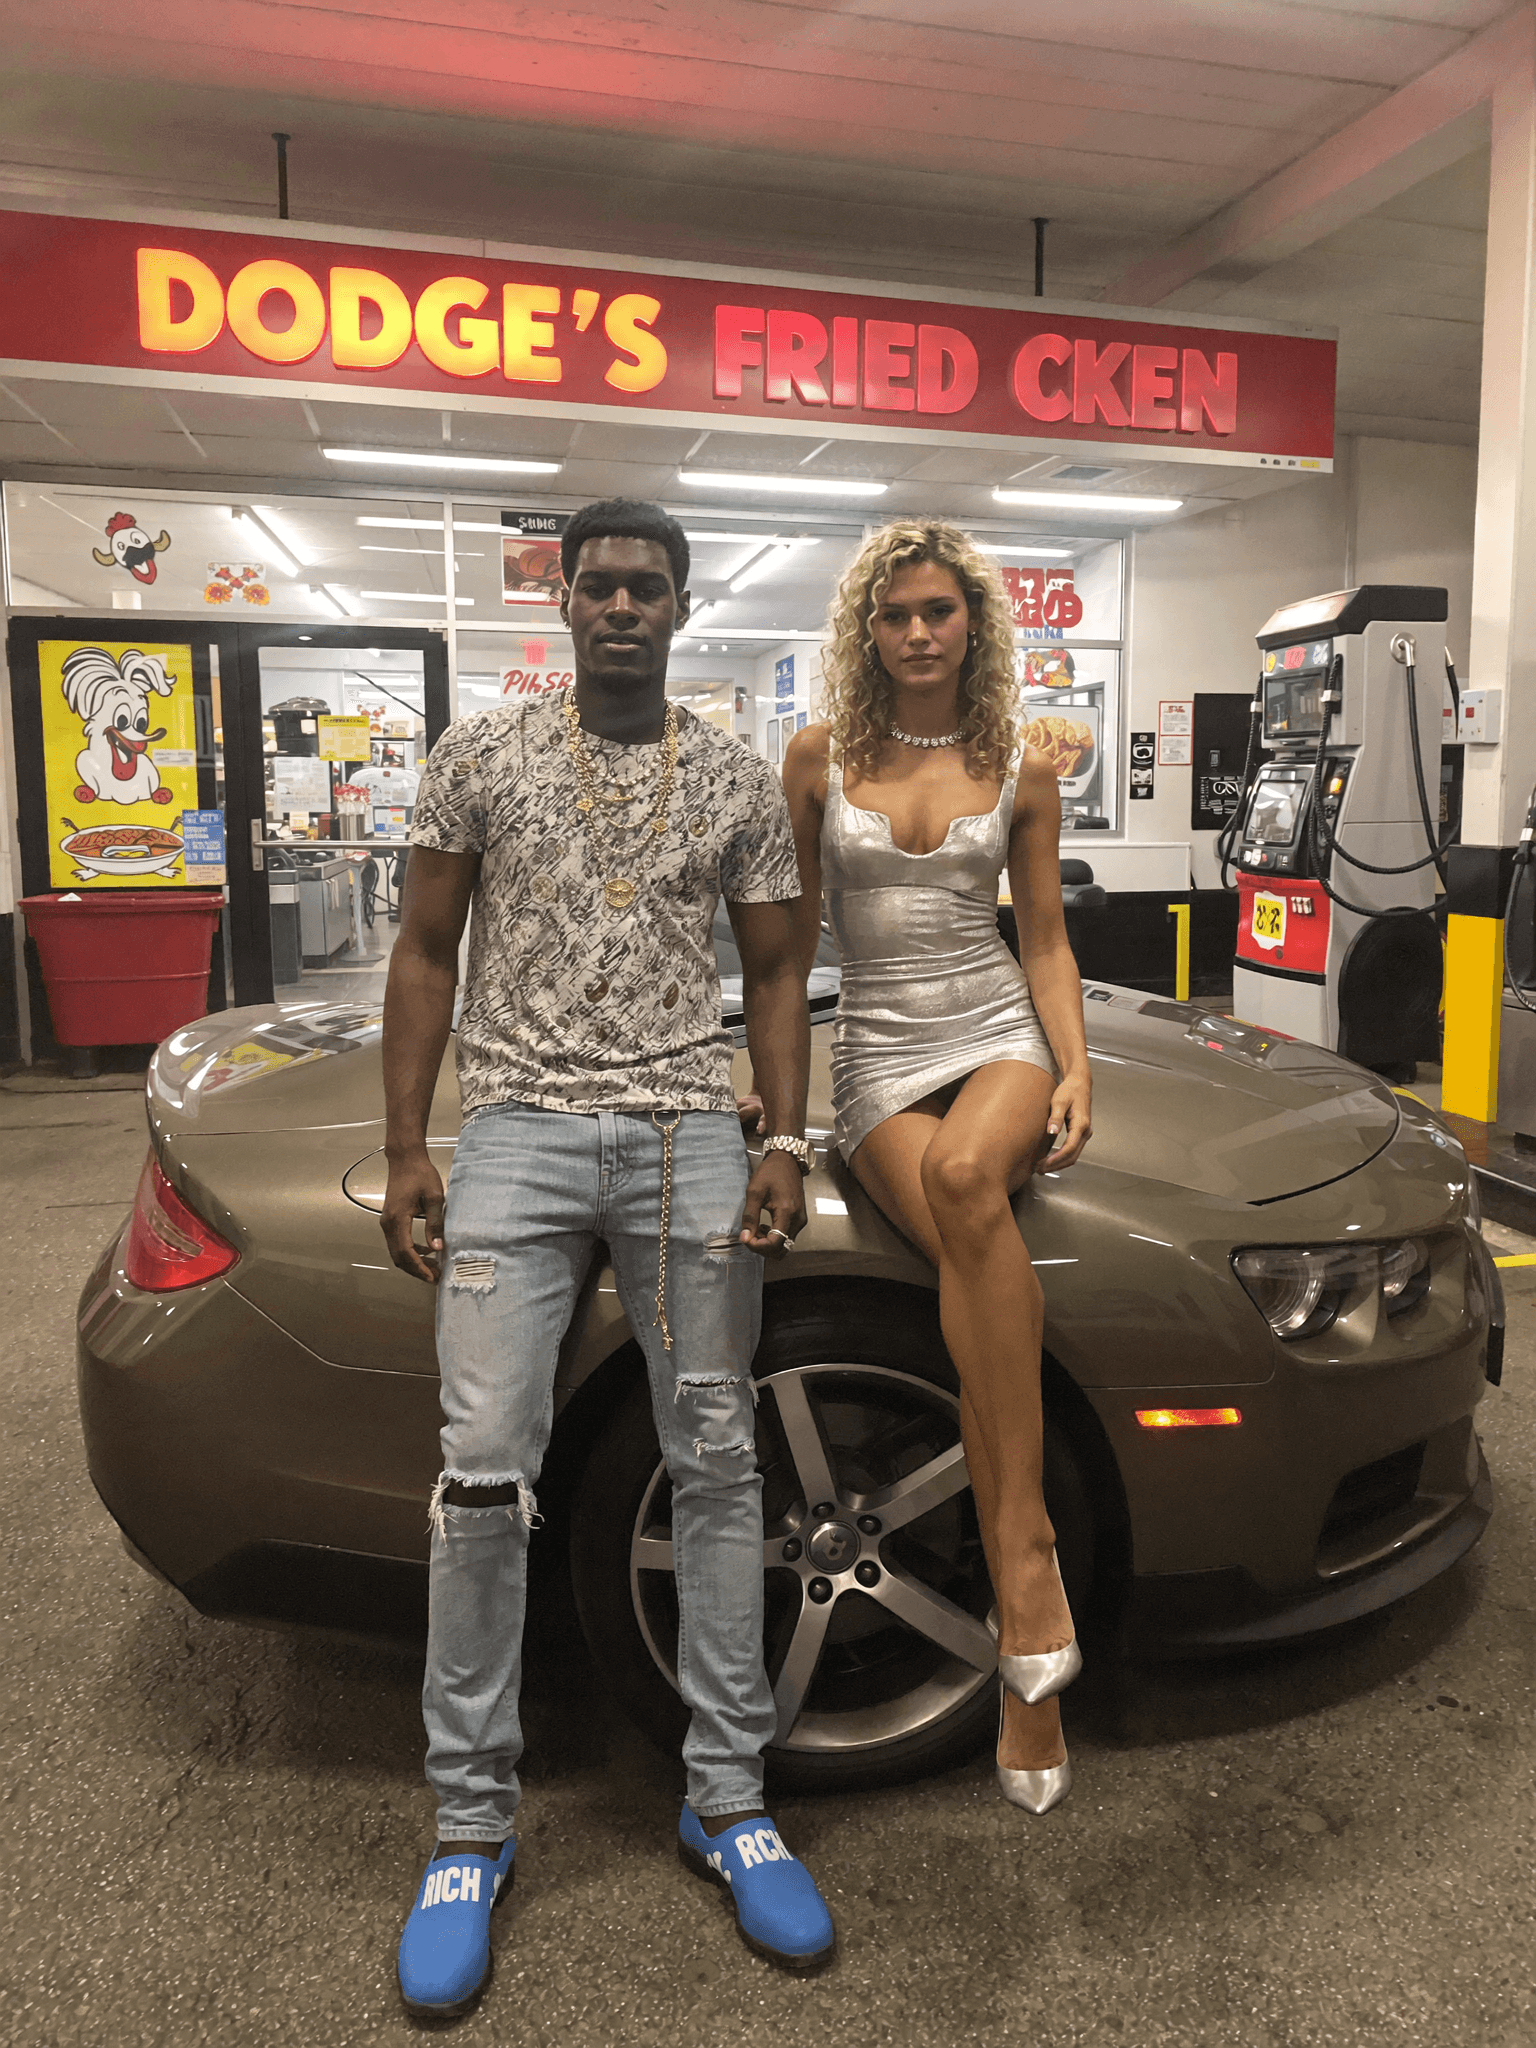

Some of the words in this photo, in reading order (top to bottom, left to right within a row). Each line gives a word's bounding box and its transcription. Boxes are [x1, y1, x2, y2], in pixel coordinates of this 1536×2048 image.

[136, 247, 669, 392] DODGE'S
[712, 304, 980, 414] FRIED
[1012, 332, 1239, 436] CKEN
[734, 1828, 794, 1870] RCH
[421, 1866, 482, 1910] RICH
